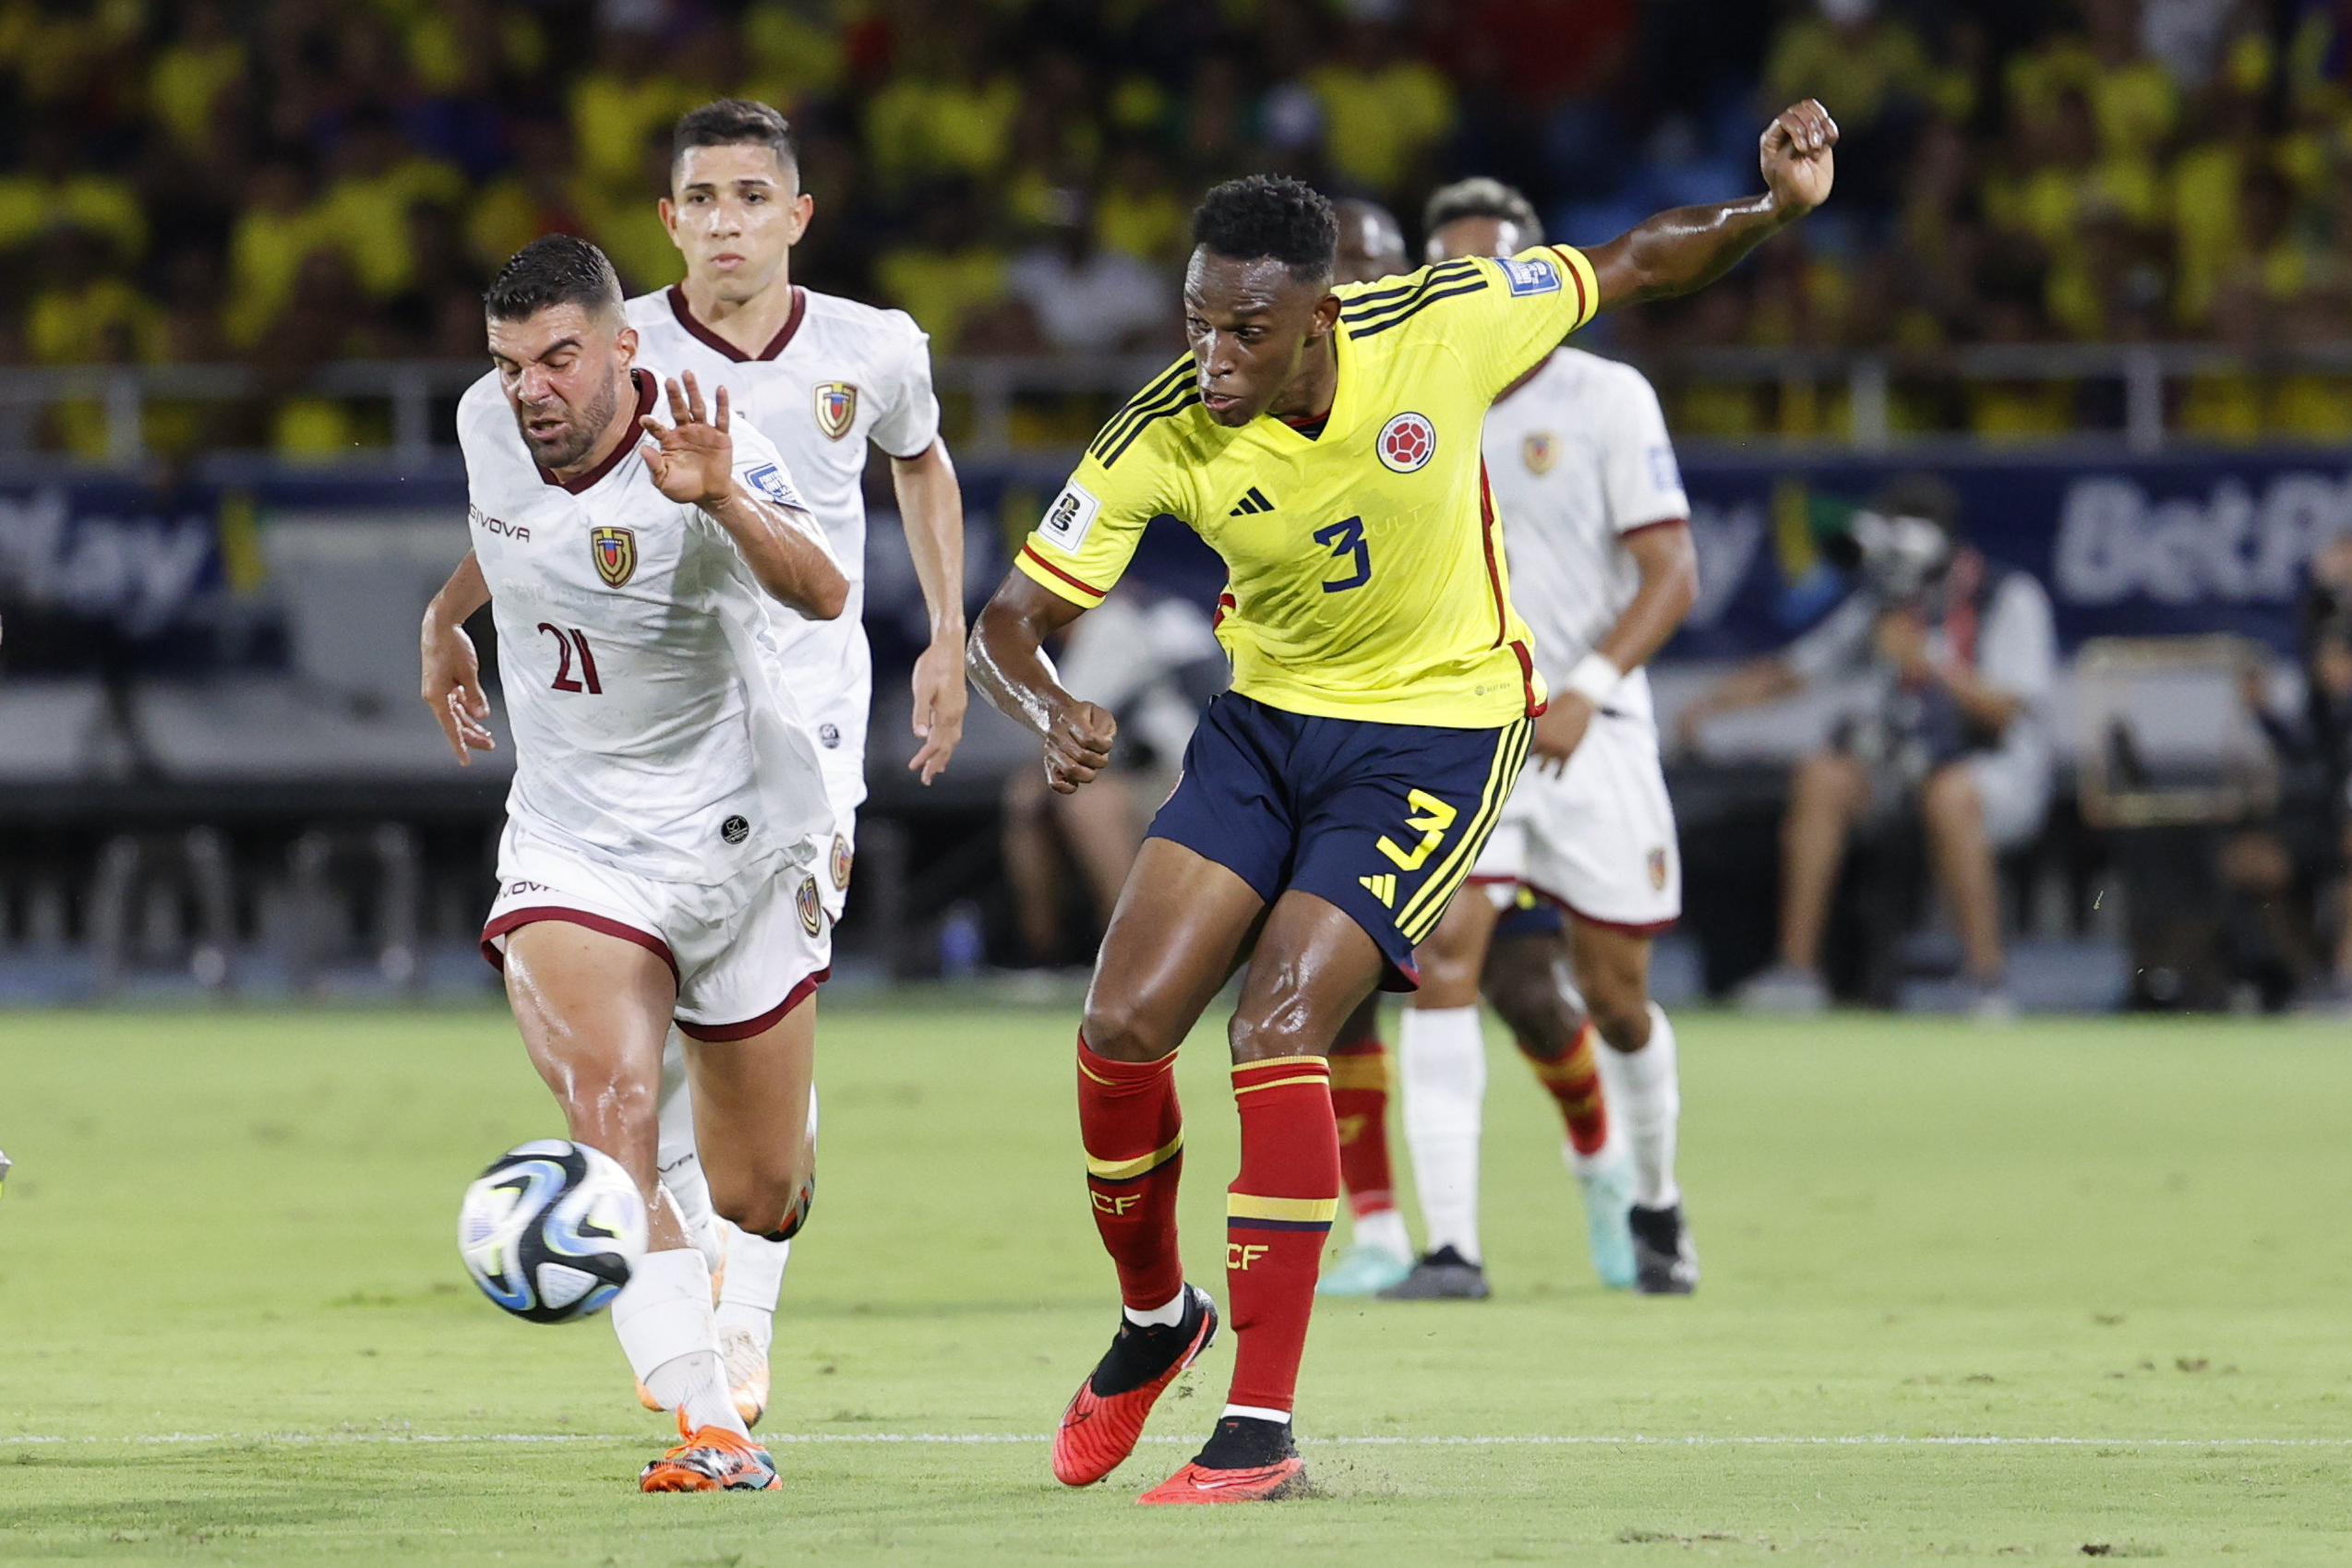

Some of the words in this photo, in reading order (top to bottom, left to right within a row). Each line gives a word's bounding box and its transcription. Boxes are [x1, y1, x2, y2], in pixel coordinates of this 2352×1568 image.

[469, 503, 531, 544] GIVOVA
[1313, 515, 1372, 593] 3
[537, 622, 603, 695] 21
[1375, 788, 1458, 871] 3
[1226, 1243, 1269, 1271] CF
